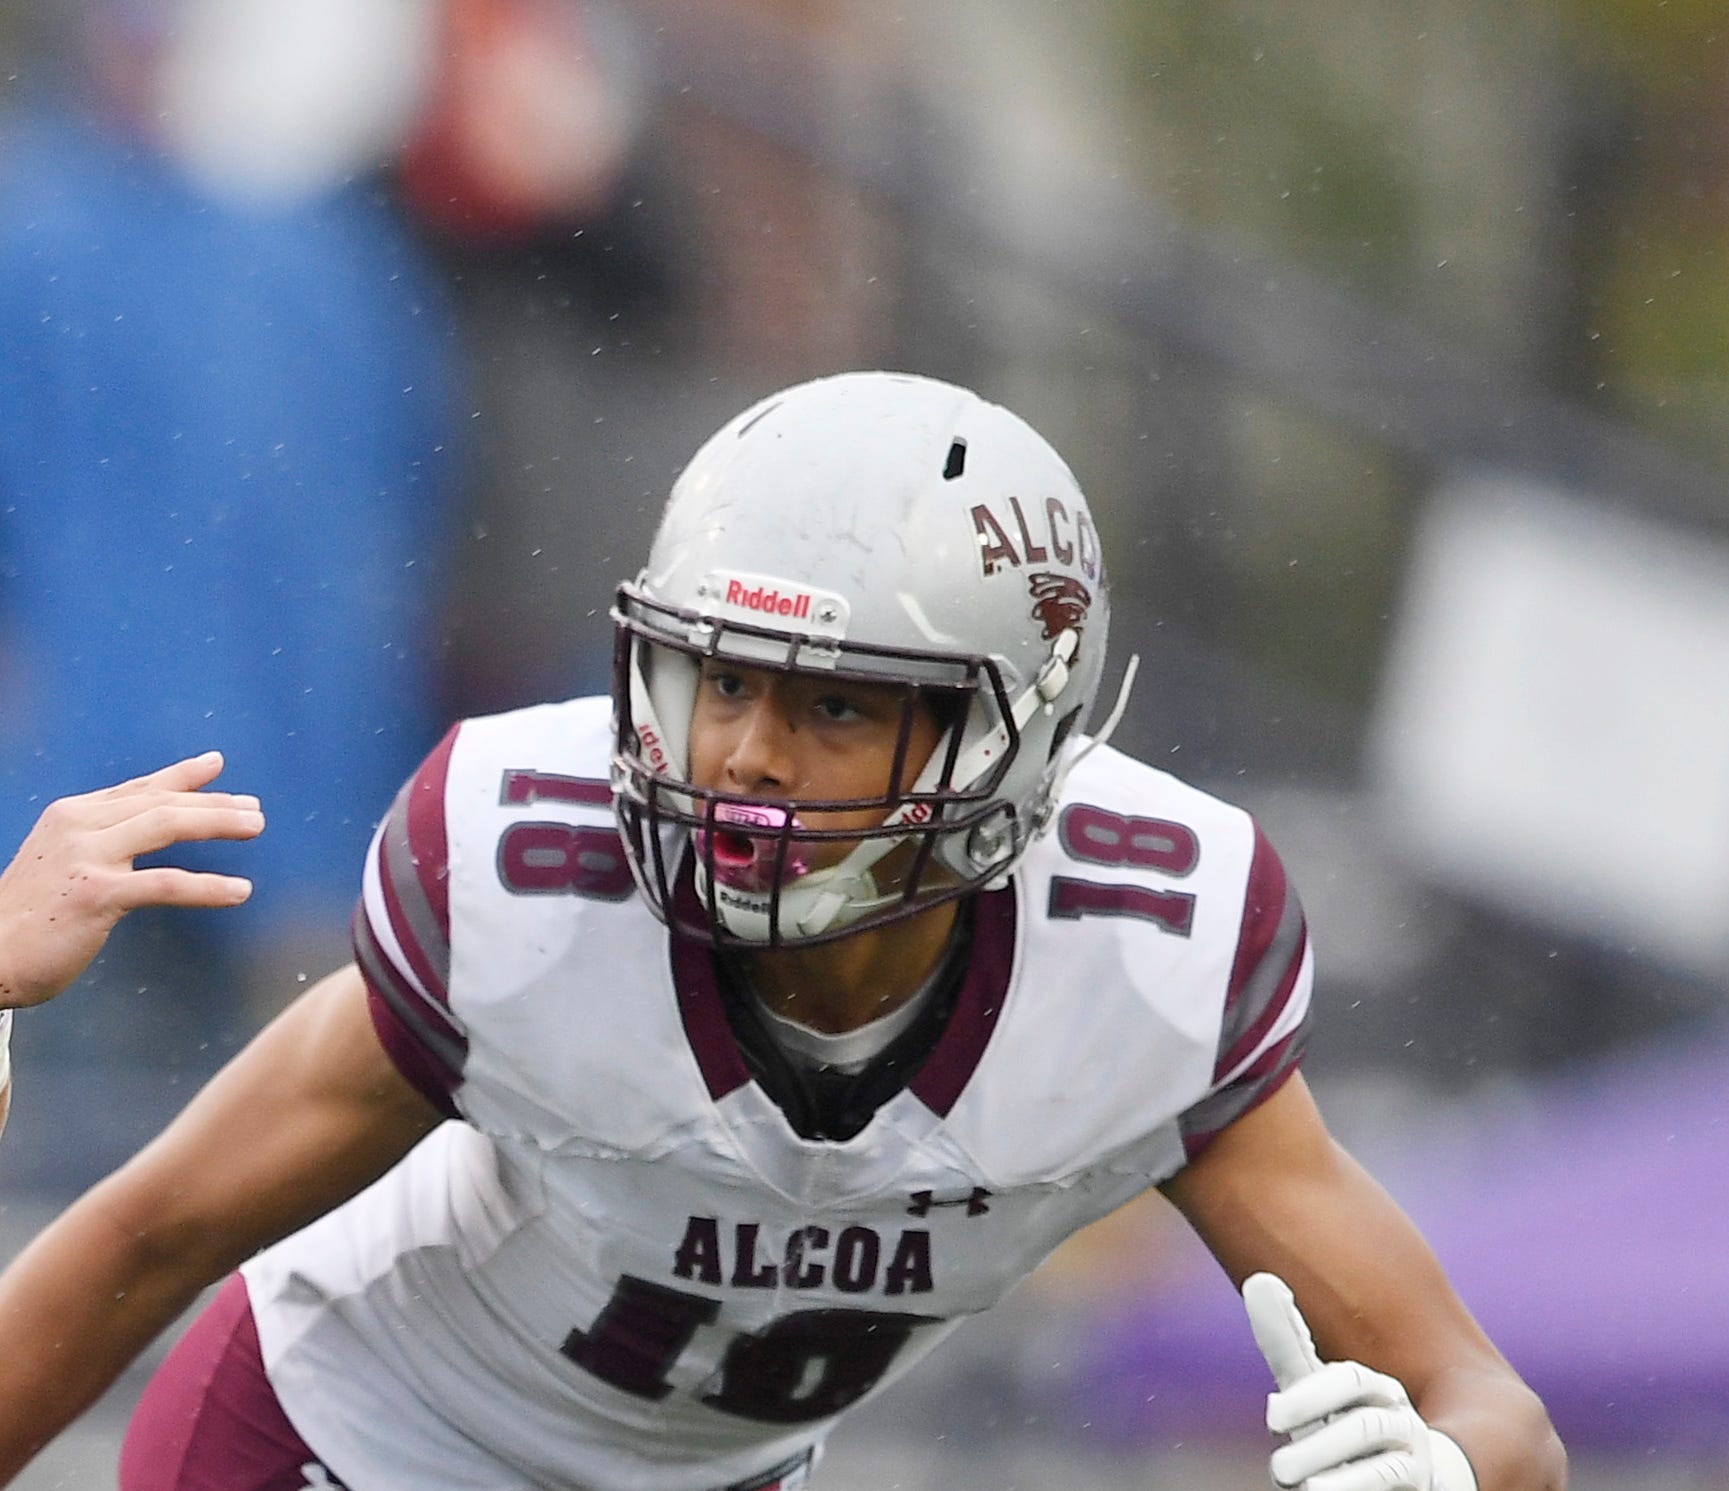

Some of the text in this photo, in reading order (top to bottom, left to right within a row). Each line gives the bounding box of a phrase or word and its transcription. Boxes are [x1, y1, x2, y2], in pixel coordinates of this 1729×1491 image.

[970, 496, 1104, 590] ALCO
[725, 579, 811, 619] Riddell
[496, 768, 638, 901] 18
[1047, 802, 1201, 937] 18
[672, 1215, 935, 1296] ALCOA
